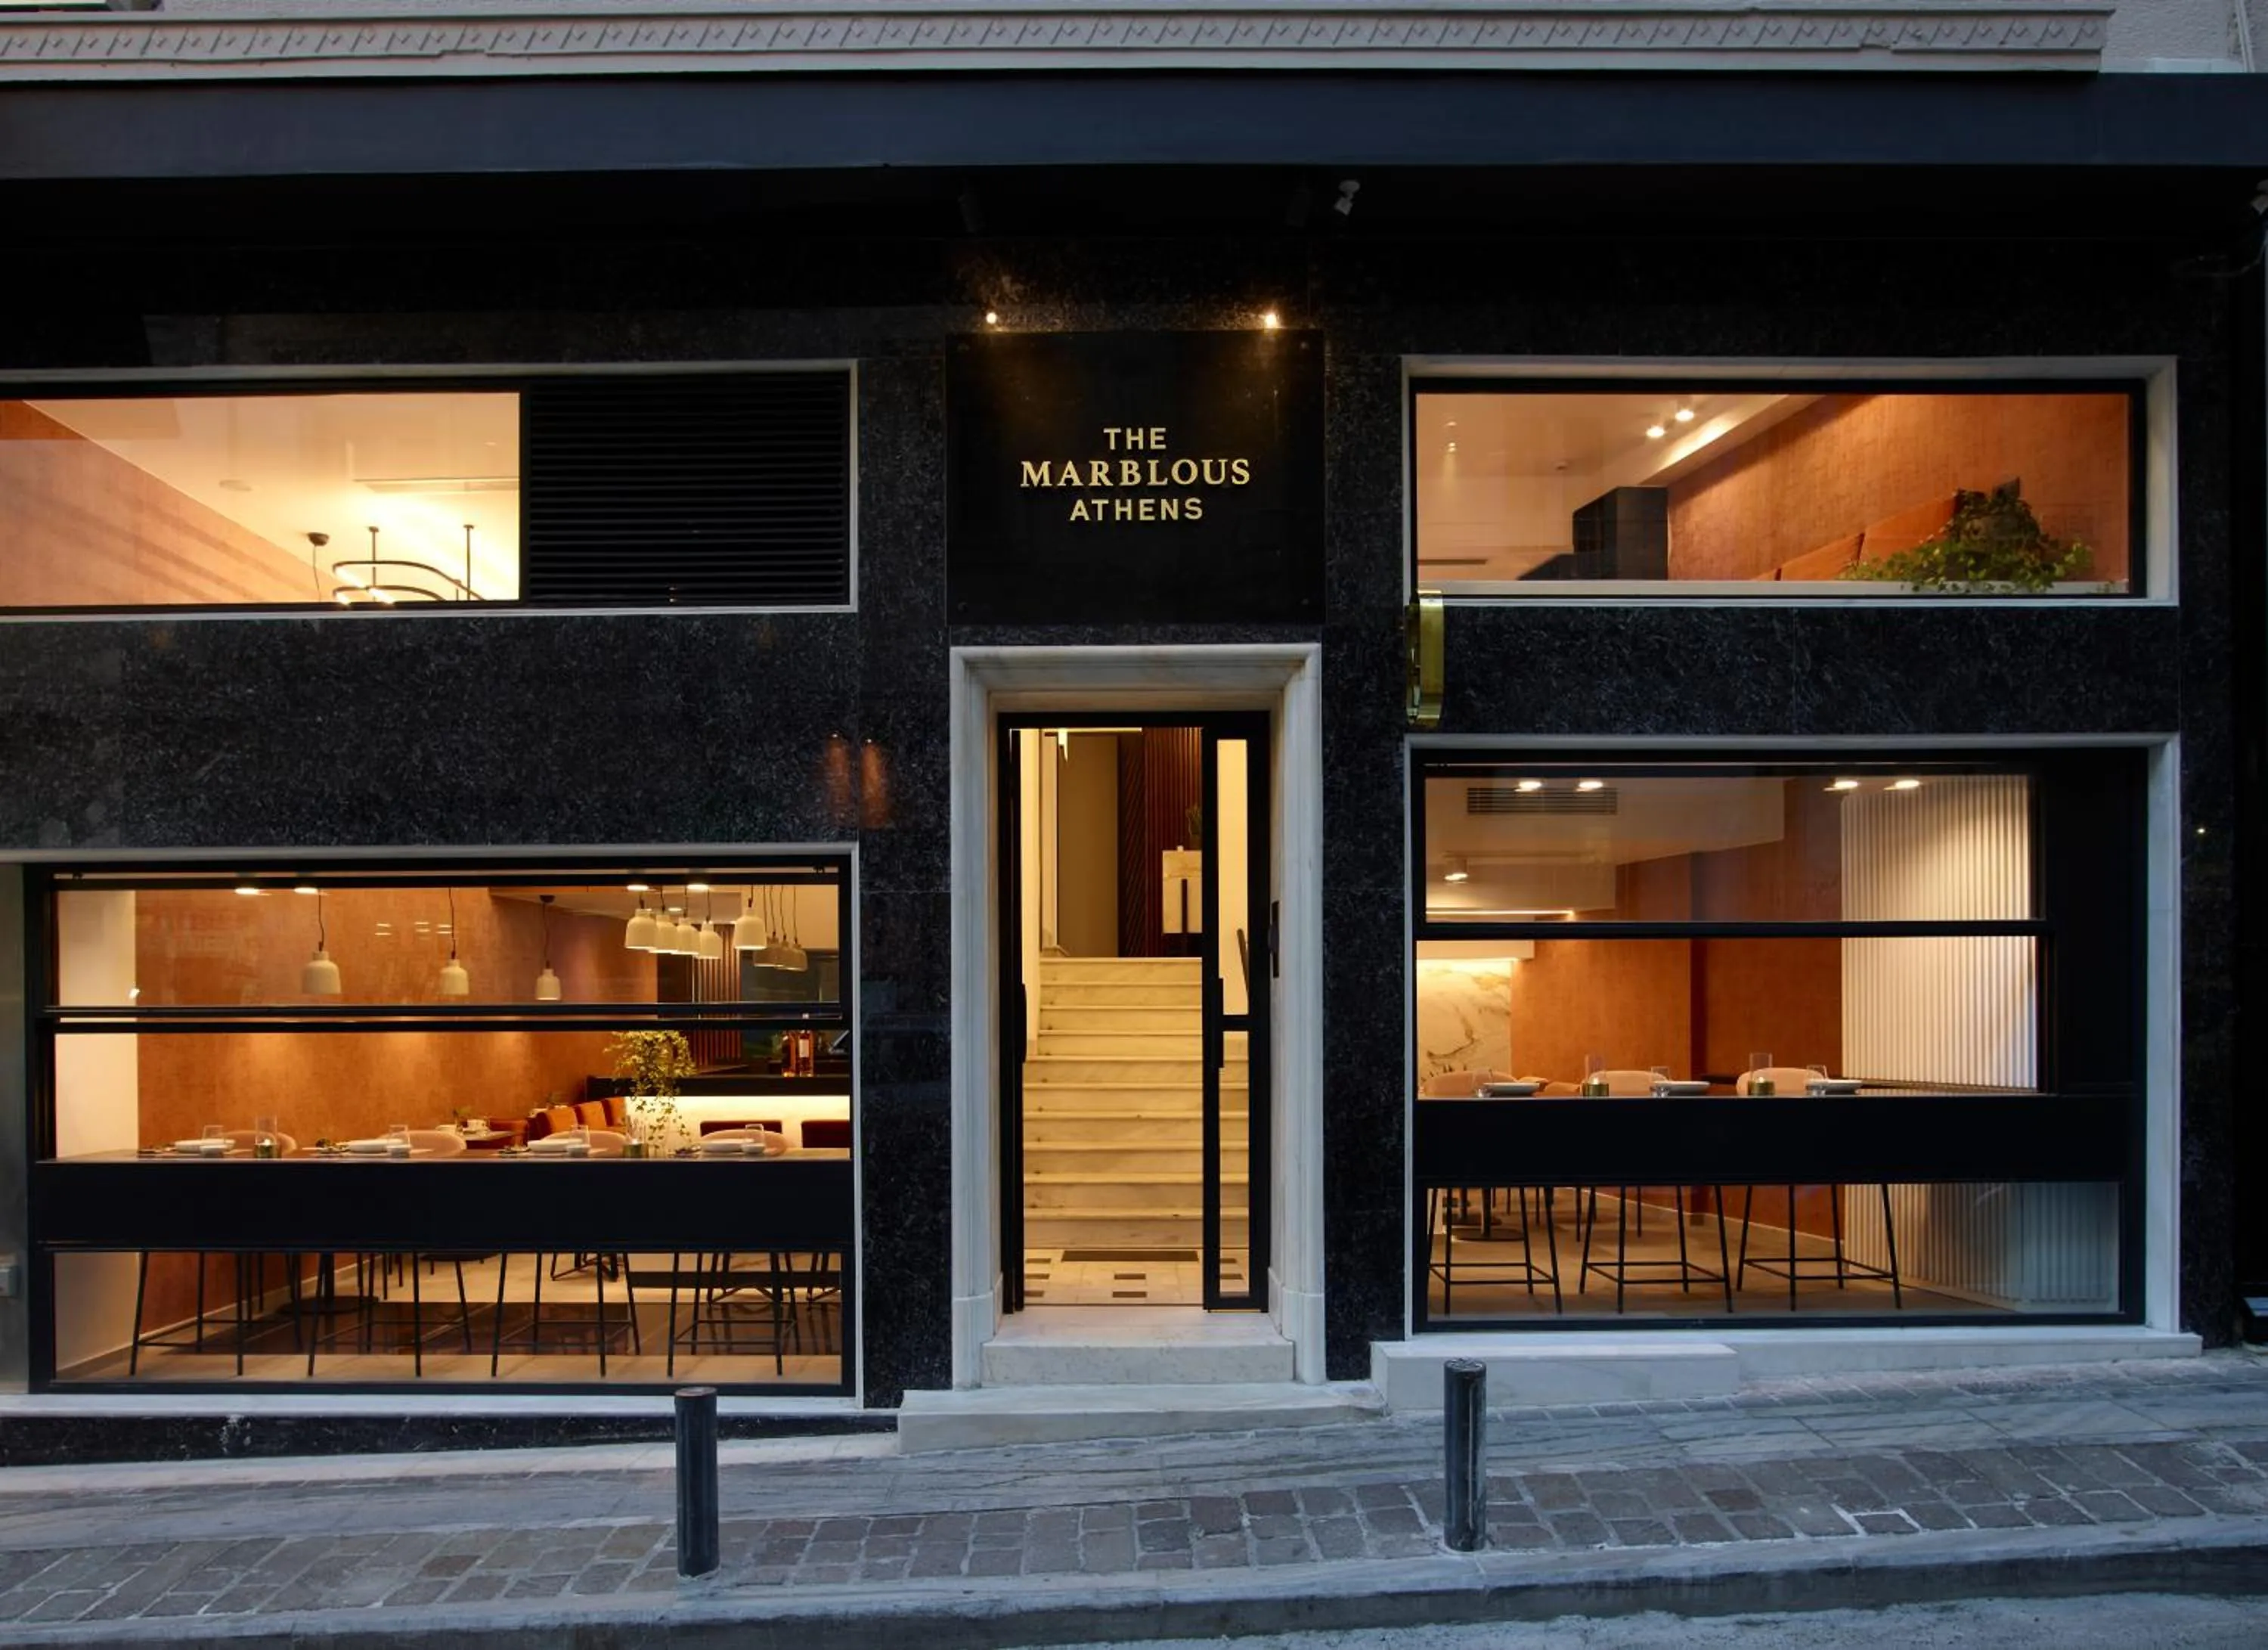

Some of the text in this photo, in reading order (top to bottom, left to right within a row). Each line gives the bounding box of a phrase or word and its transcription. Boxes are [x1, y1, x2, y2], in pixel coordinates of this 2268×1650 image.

[1103, 427, 1167, 451] THE
[1020, 458, 1250, 488] MARBLOUS
[1069, 497, 1204, 522] ATHENS
